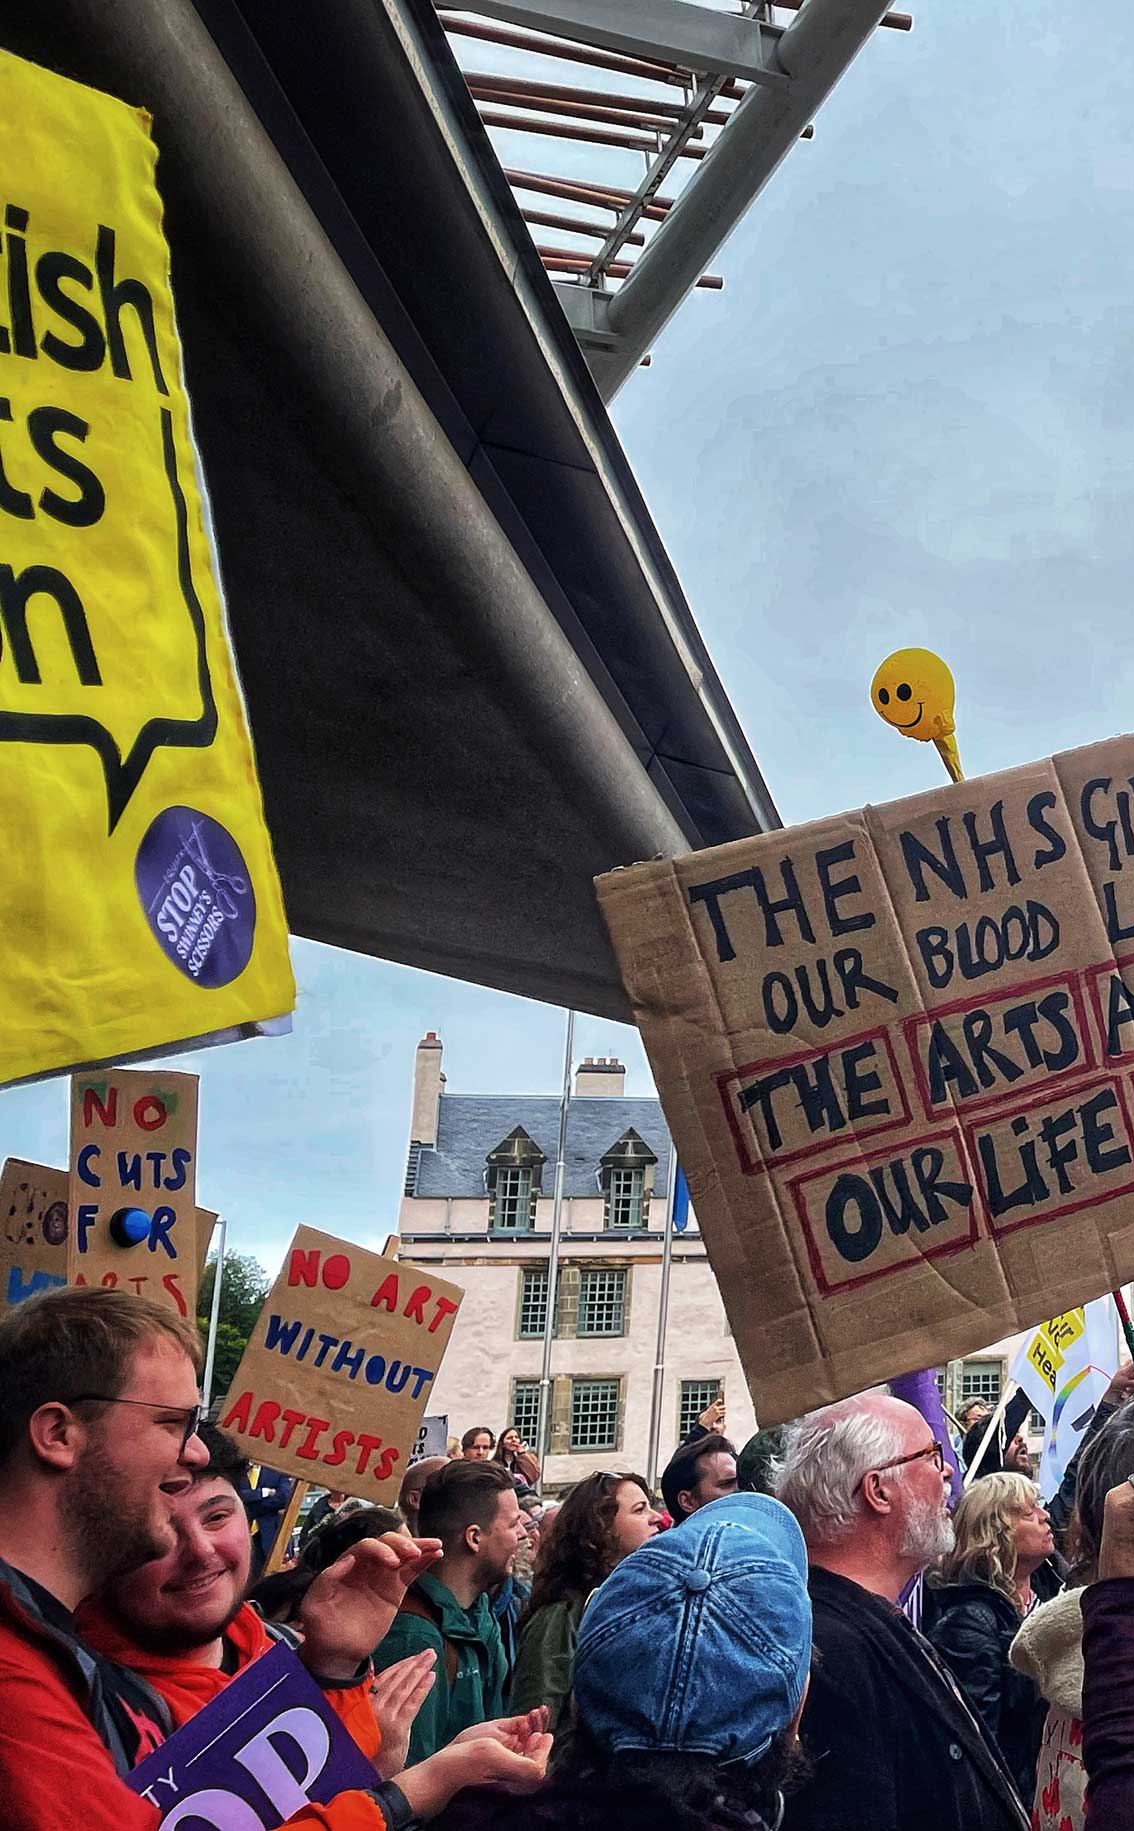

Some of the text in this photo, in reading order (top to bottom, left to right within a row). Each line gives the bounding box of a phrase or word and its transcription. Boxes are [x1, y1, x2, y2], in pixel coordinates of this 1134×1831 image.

[157, 865, 199, 943] STOP
[687, 840, 876, 962] THE
[900, 791, 1067, 901] NHS
[176, 890, 211, 959] SWINNEY'S
[188, 905, 225, 977] SCISSORS
[762, 948, 899, 1034] OUR
[915, 899, 1060, 988] BLOOD
[83, 1087, 167, 1131] NO
[737, 1040, 891, 1150] THE
[929, 992, 1079, 1103] ARTS
[77, 1144, 192, 1191] CUTS
[825, 1147, 974, 1262] OUR
[77, 1205, 178, 1259] FOR
[287, 1249, 458, 1333] NO ART
[264, 1314, 434, 1400] WITHOUT
[223, 1391, 400, 1480] ARTISTS
